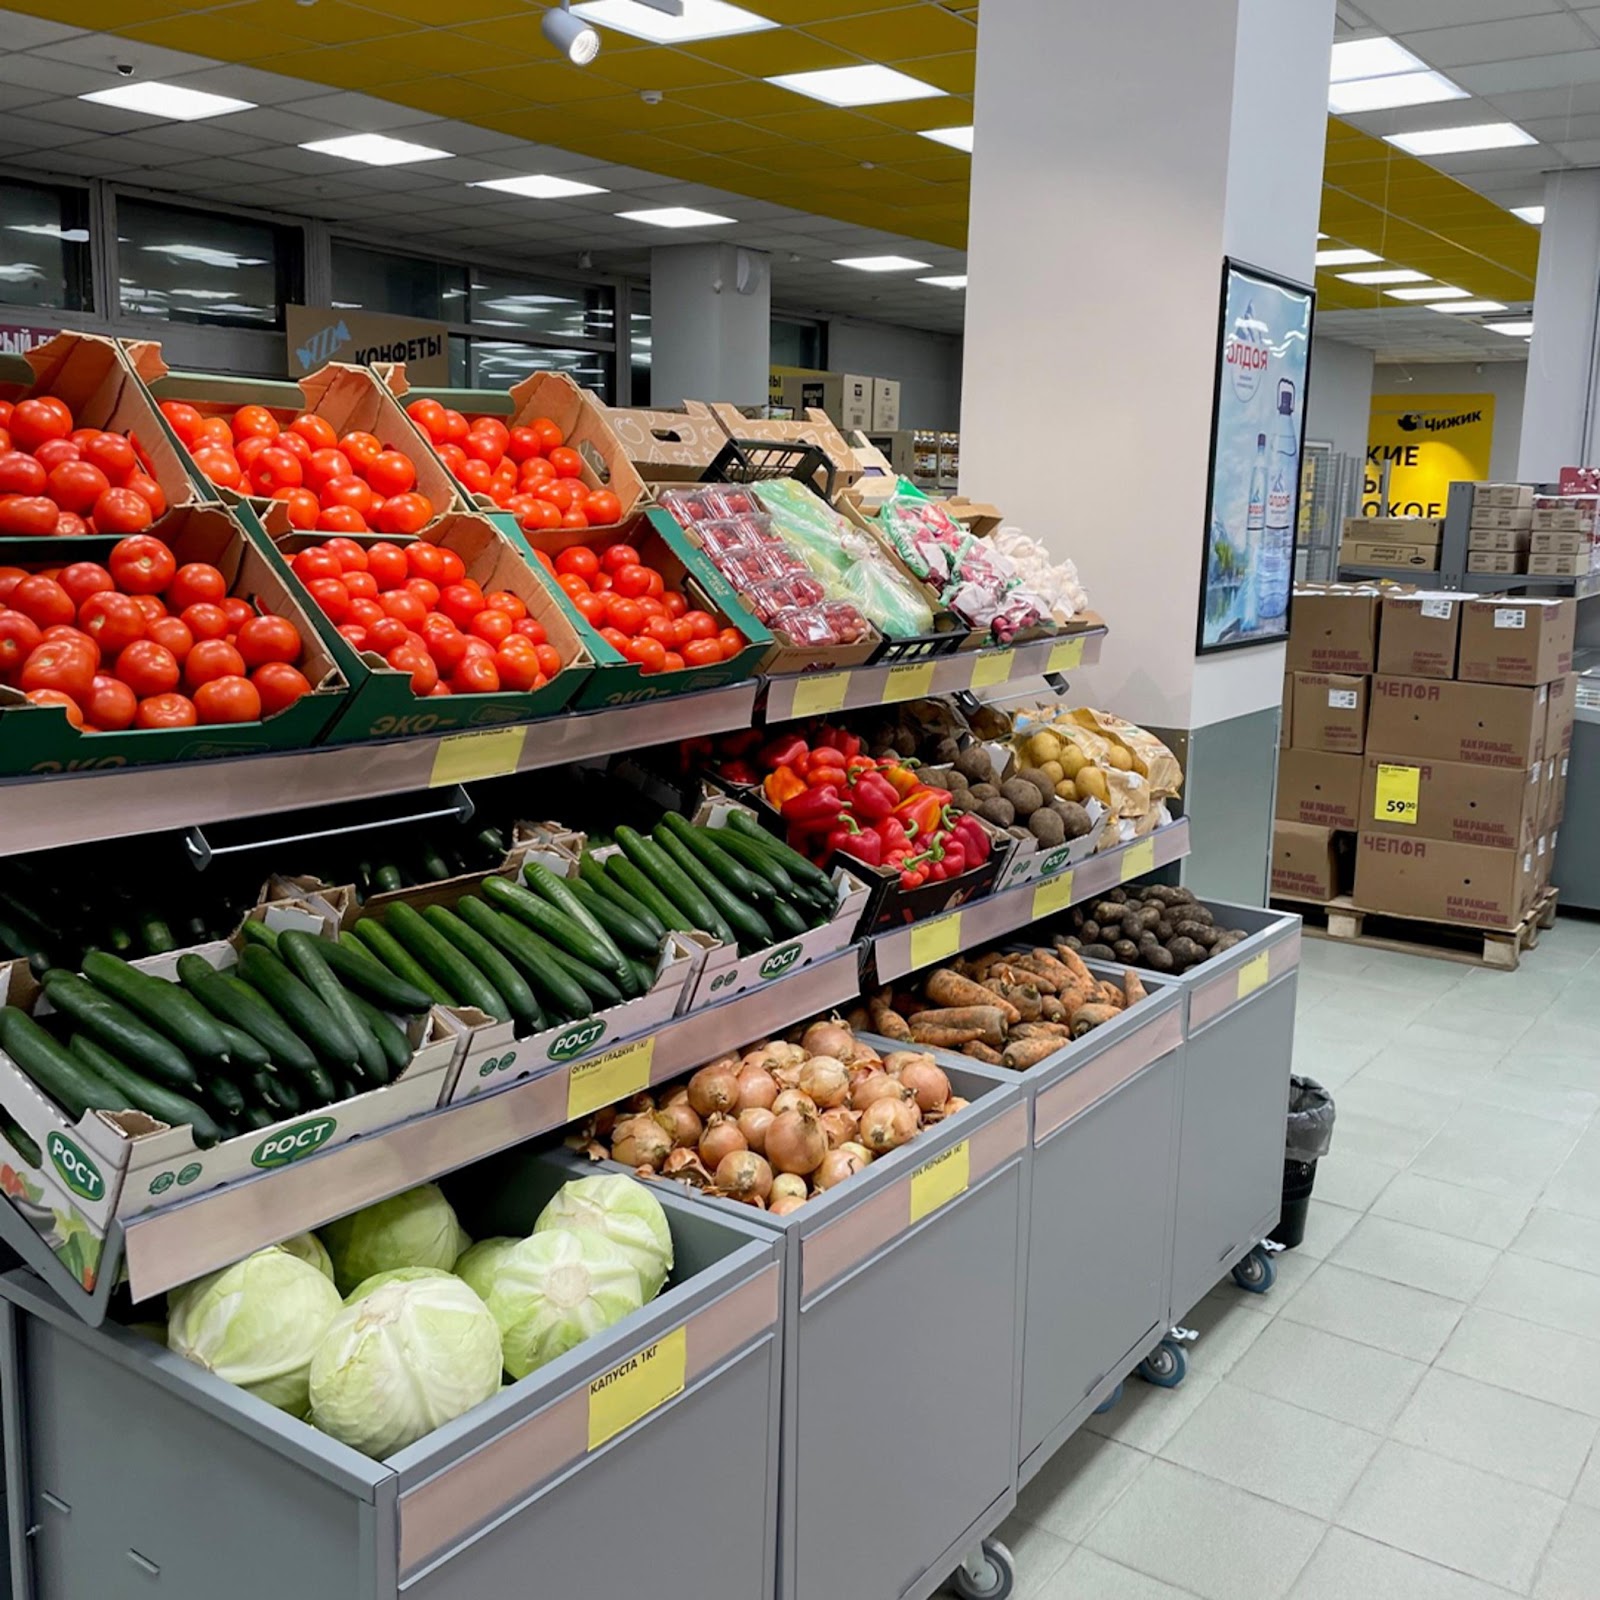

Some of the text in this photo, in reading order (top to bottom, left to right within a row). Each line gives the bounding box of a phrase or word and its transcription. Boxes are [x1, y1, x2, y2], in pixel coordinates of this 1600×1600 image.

[355, 334, 441, 366] КОНФЕТЫ
[1424, 410, 1481, 432] Чижик
[763, 947, 800, 973] РОСТ
[553, 1024, 602, 1054] РОСТ
[571, 1057, 602, 1074] ОГУРЦЫ
[261, 1122, 330, 1161] РОСТ
[53, 1137, 100, 1191] РОСТ
[590, 1358, 638, 1396] КАПУСТА
[641, 1344, 659, 1364] 1КГ
